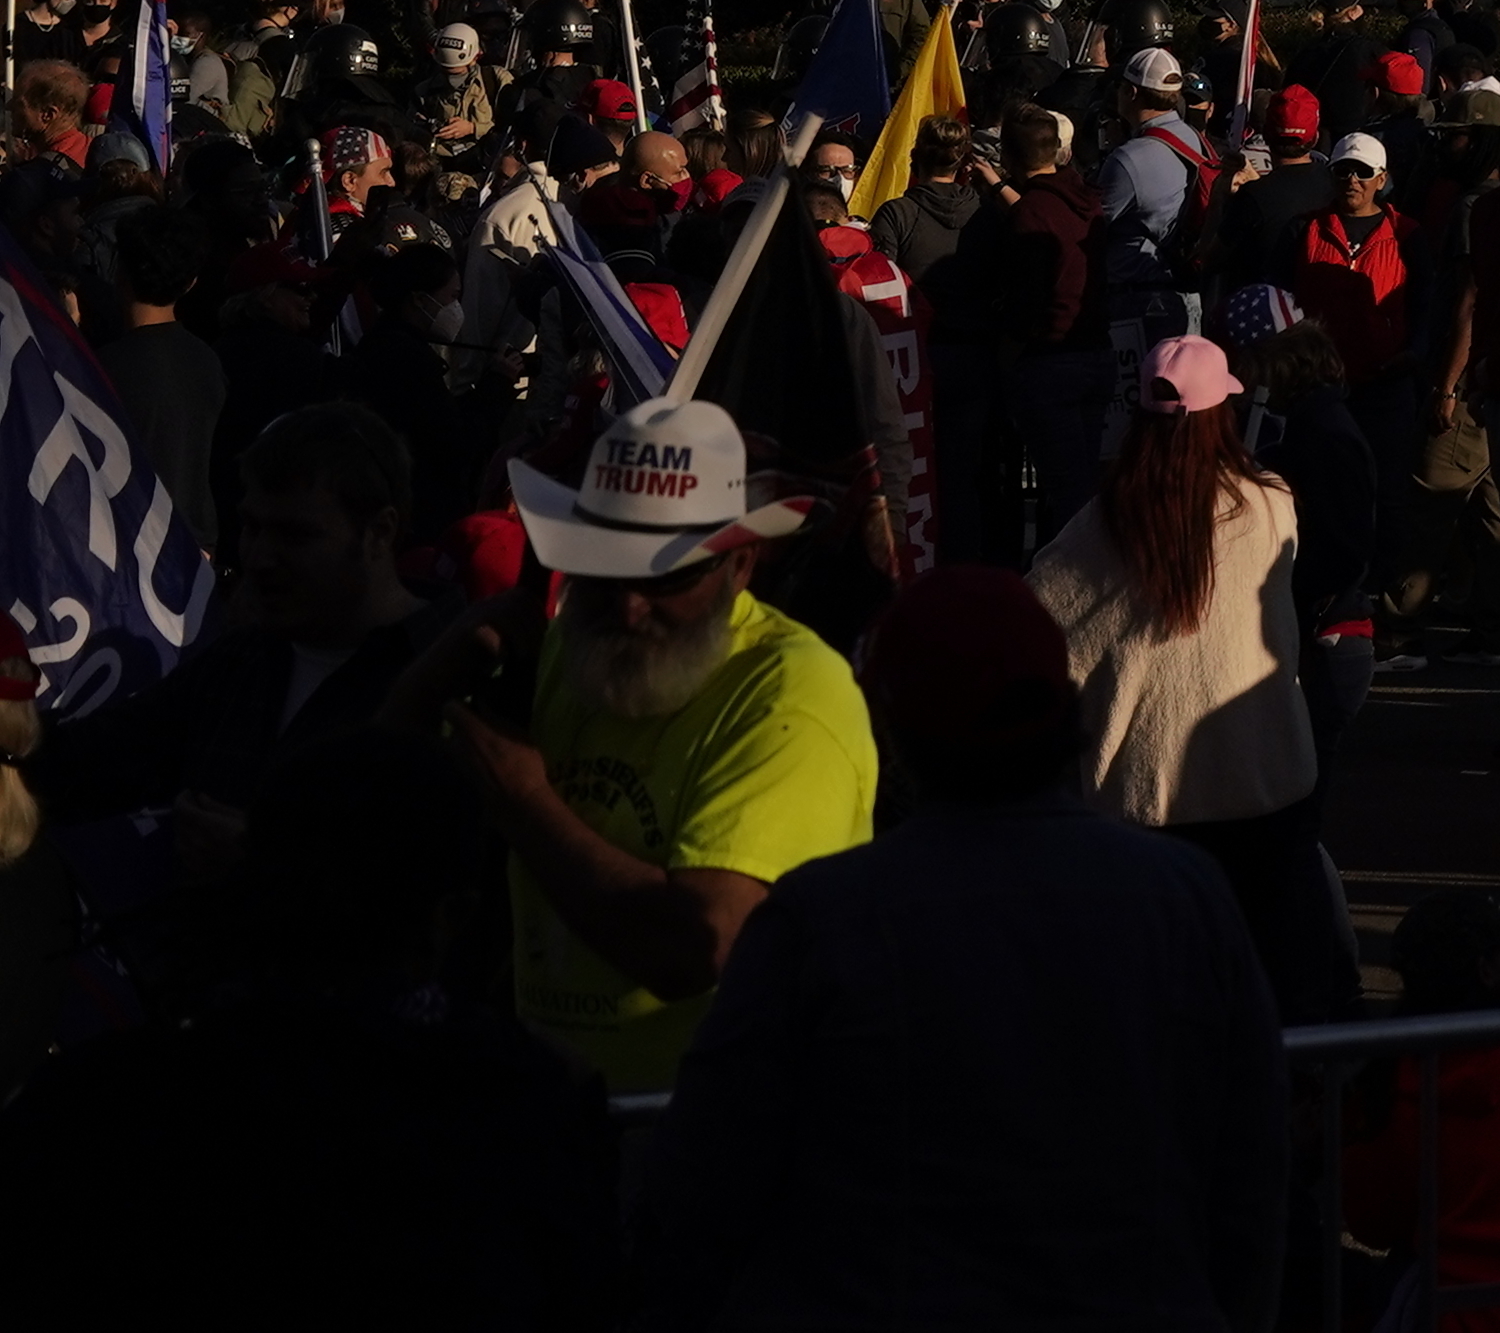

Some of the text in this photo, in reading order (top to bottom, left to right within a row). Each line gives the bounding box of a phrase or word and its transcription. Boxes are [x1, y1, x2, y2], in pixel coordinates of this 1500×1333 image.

[439, 37, 463, 49] PRESS
[1118, 347, 1142, 415] STO
[606, 438, 692, 471] TEAM
[595, 464, 698, 499] TRUMP
